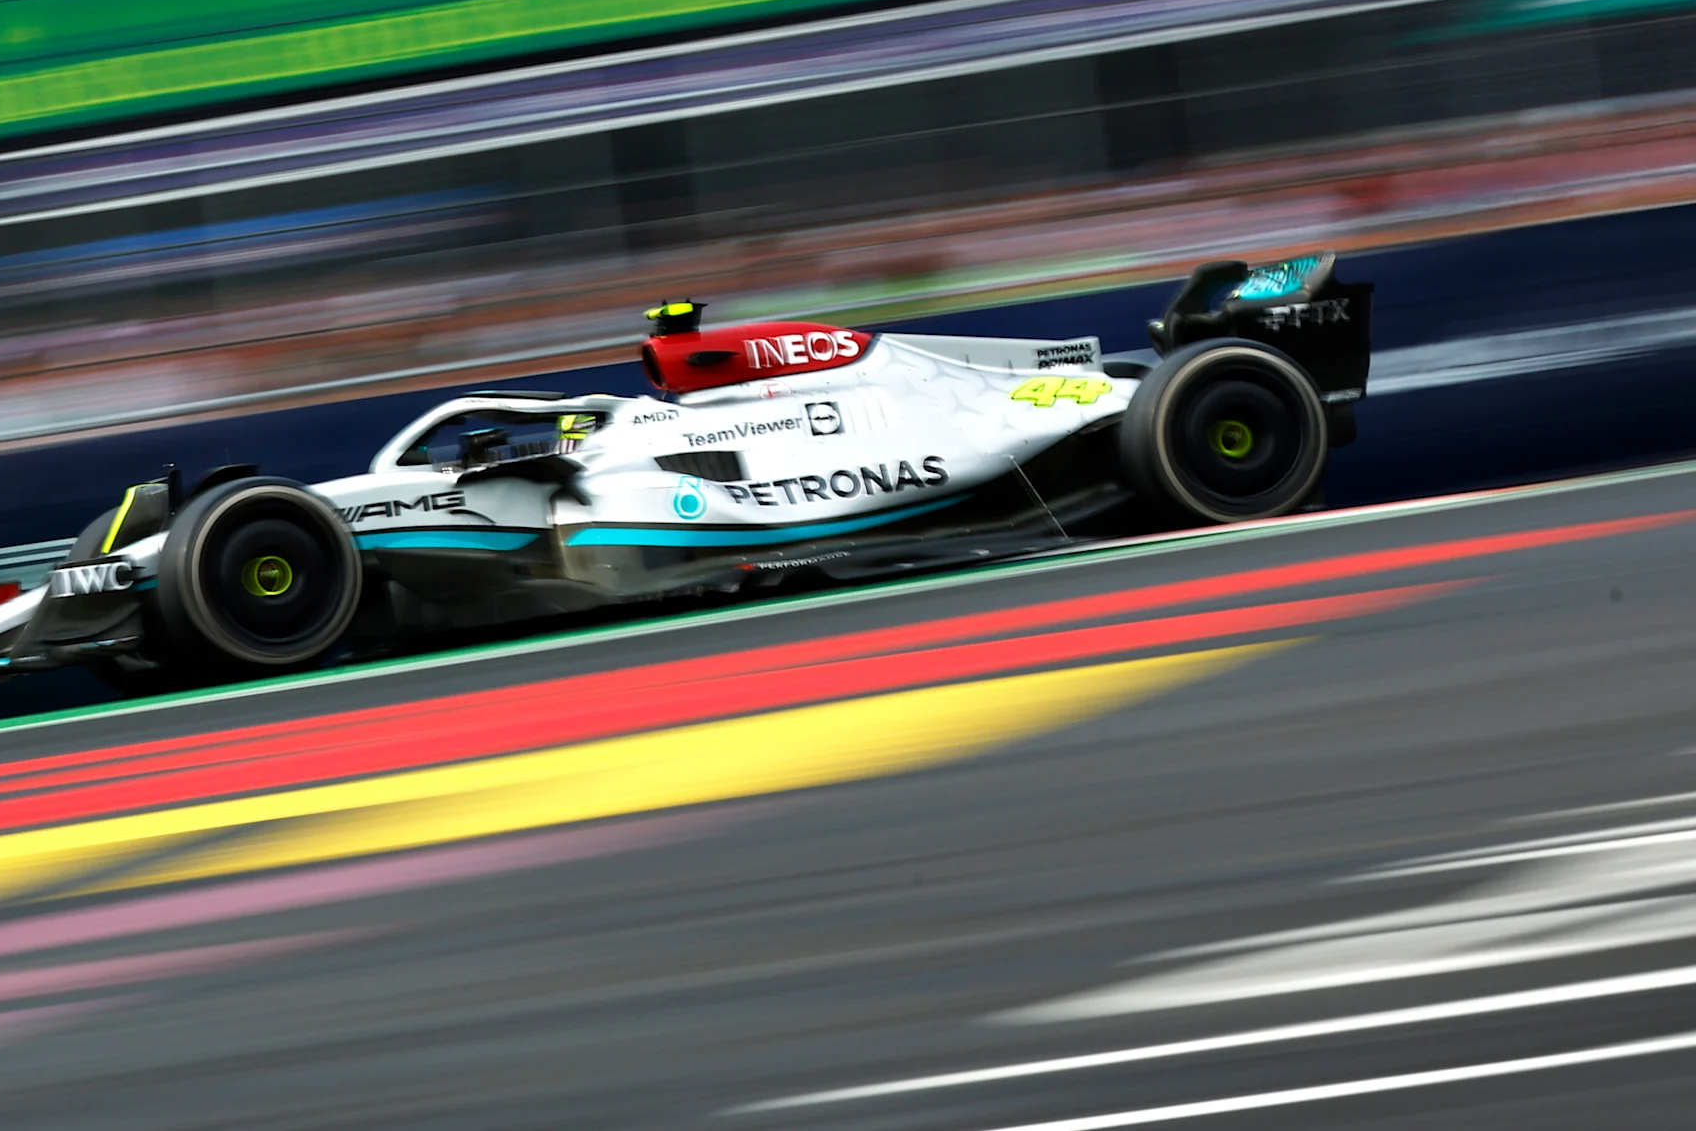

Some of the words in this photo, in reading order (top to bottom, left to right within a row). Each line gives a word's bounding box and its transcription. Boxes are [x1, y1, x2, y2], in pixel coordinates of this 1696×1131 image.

[742, 330, 860, 370] INEOS
[1035, 343, 1093, 358] PETRONAS
[1010, 376, 1113, 407] 44
[632, 409, 669, 426] AMD
[682, 416, 804, 448] TeamViewer
[724, 455, 950, 507] PETRONAS
[47, 561, 134, 599] IWC
